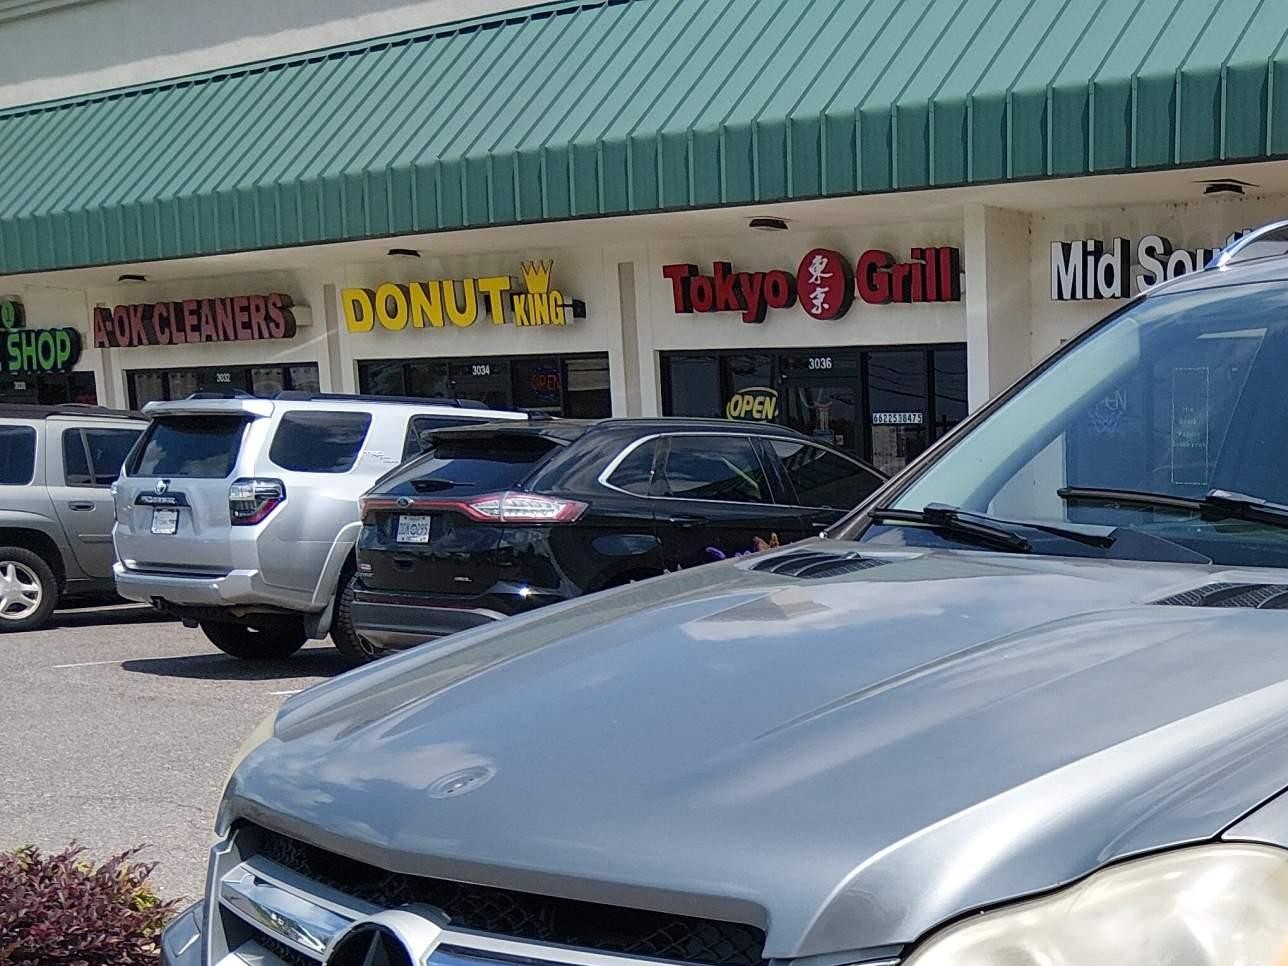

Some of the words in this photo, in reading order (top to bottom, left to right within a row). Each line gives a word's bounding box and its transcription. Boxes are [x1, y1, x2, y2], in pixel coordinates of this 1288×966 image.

[662, 261, 797, 323] Tokyo
[808, 254, 833, 315] 東京
[856, 248, 960, 304] Grill
[1050, 237, 1129, 301] Mid
[94, 305, 150, 348] A-OK
[152, 293, 286, 345] CLEANERS
[341, 276, 511, 333] DONUT
[513, 290, 565, 326] KING
[7, 330, 72, 371] SHOP
[472, 365, 490, 376] 3034
[808, 357, 833, 370] 3036
[730, 395, 776, 420] OPEN
